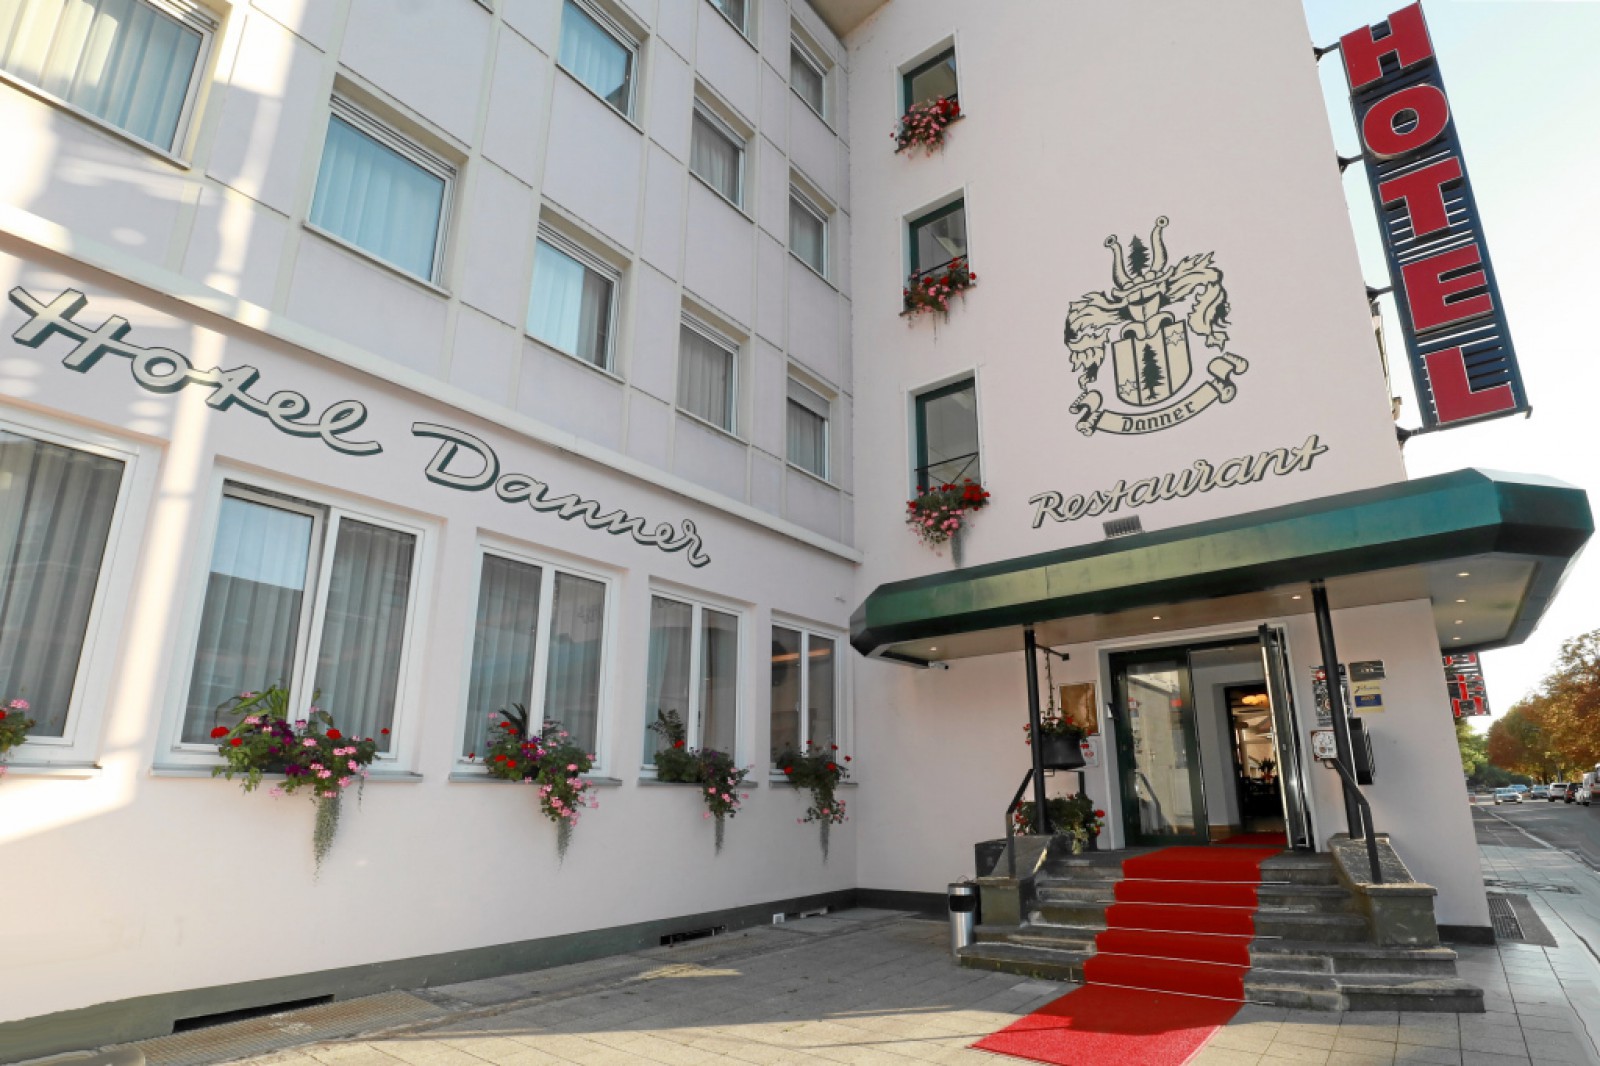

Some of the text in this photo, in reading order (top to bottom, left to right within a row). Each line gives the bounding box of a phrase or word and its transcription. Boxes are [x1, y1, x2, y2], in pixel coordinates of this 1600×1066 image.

[1340, 2, 1516, 426] HOTEL
[8, 286, 711, 568] Hotel Danner
[1028, 434, 1328, 529] Restaurant
[1121, 400, 1195, 432] Danner
